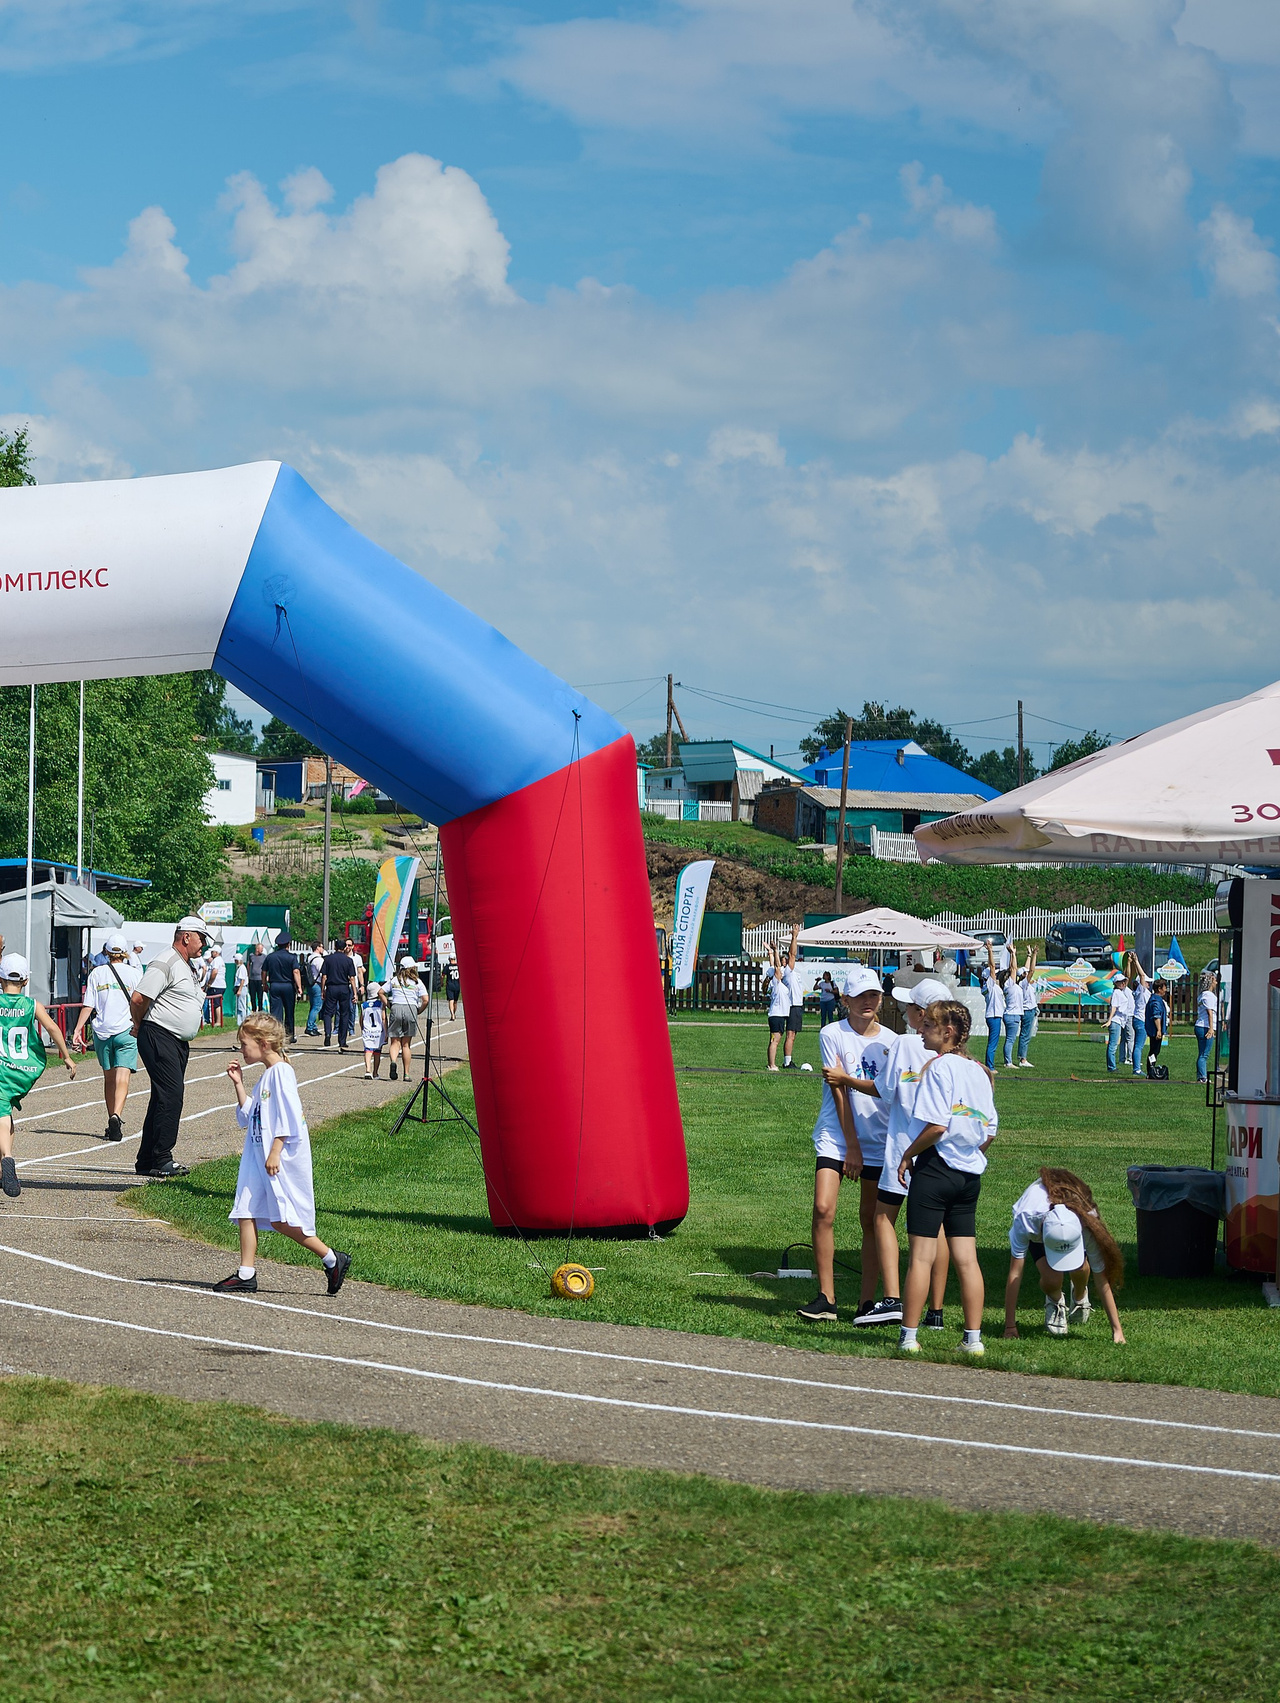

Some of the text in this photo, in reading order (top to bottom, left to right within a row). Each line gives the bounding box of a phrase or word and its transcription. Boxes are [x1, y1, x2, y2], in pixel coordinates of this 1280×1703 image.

[680, 886, 695, 932] СПОРТА
[450, 970, 459, 980] 10
[0, 1007, 25, 1017] ОСИПОВ
[369, 1012, 377, 1028] 1
